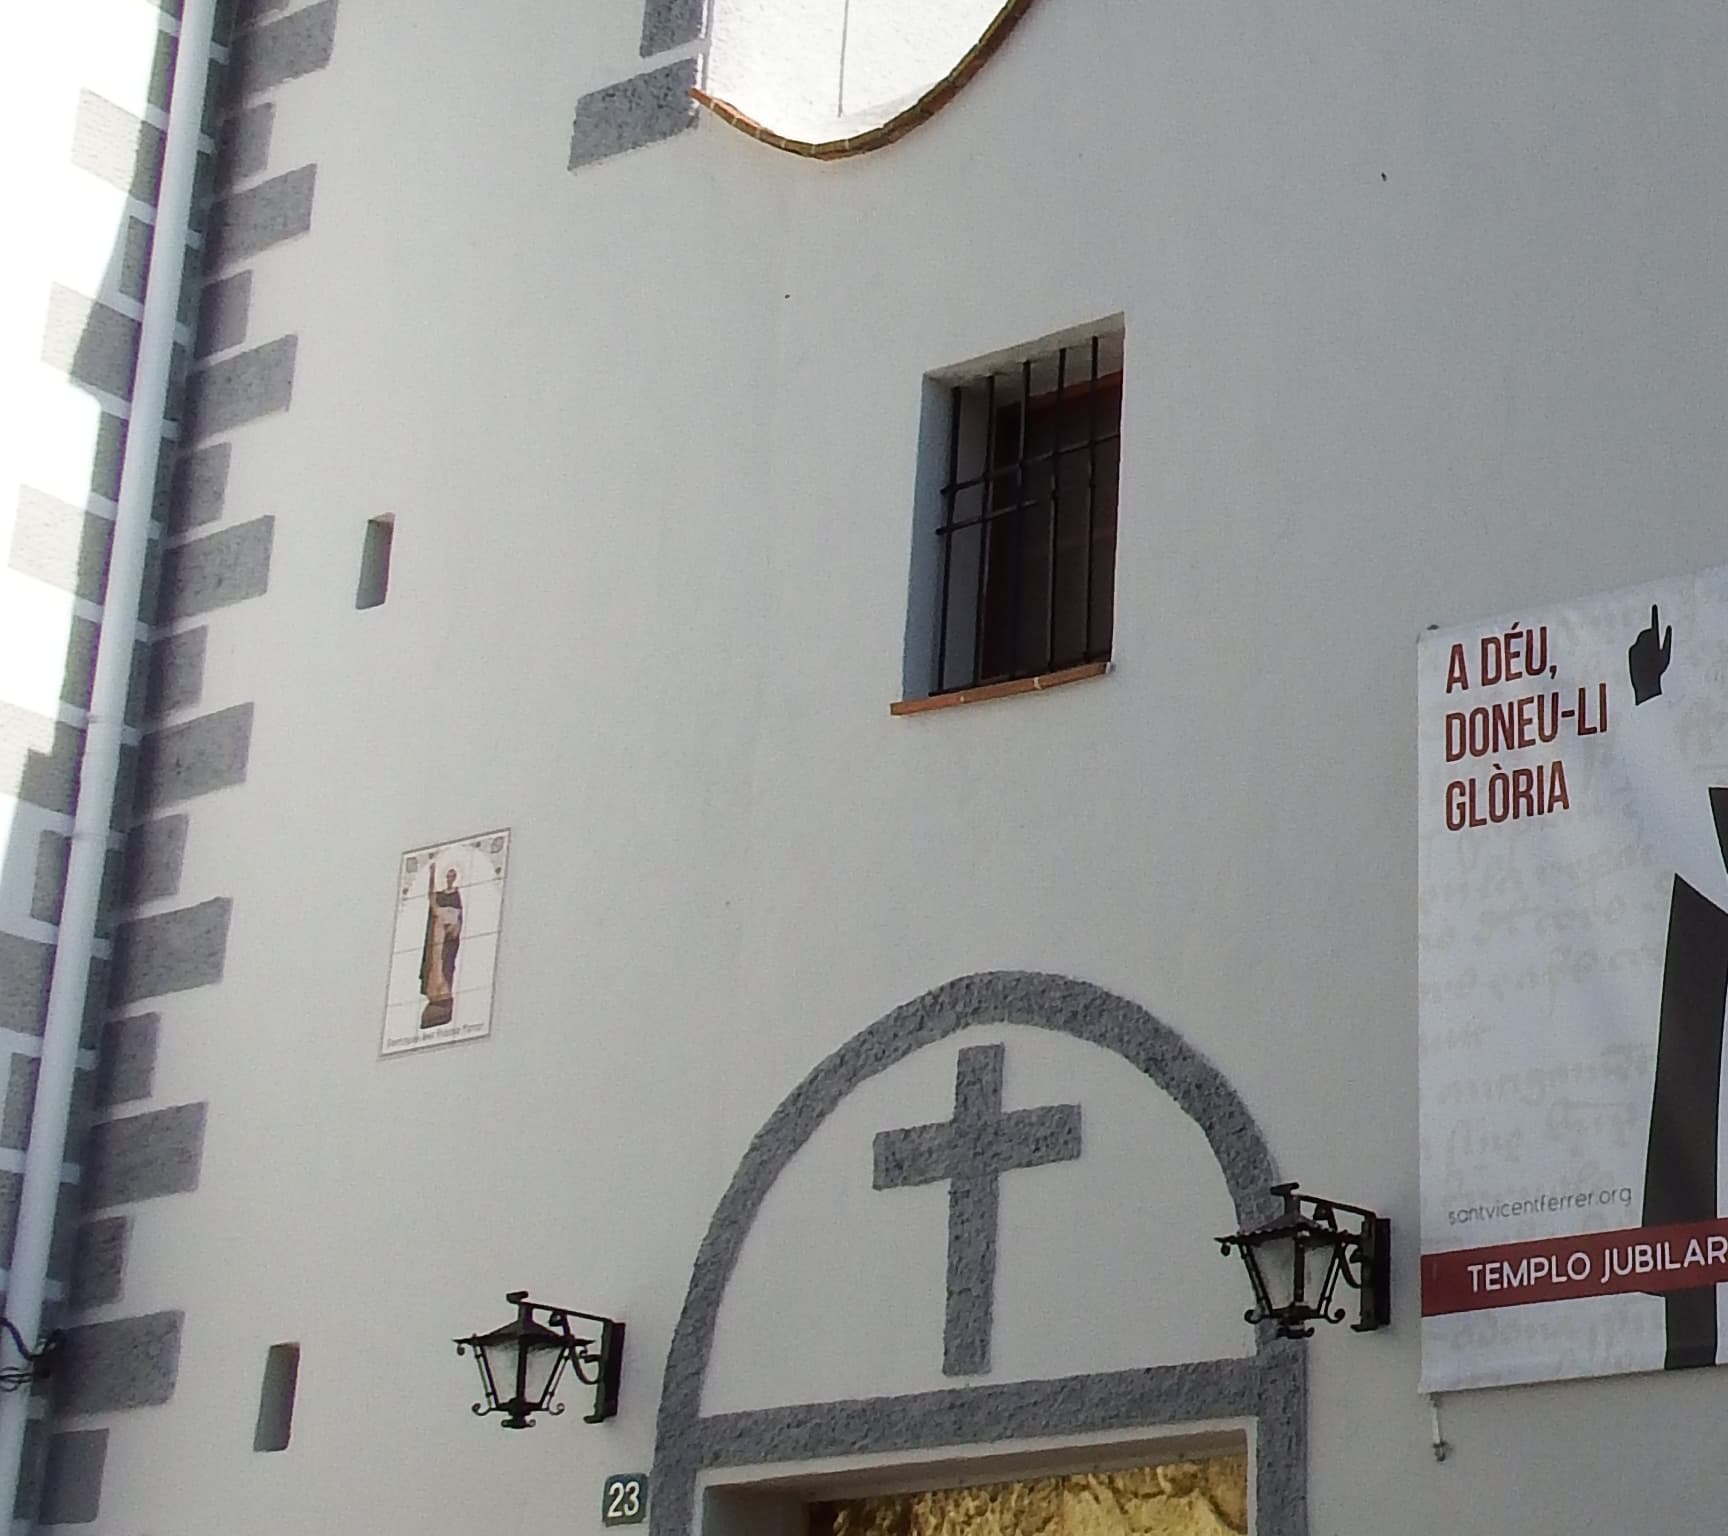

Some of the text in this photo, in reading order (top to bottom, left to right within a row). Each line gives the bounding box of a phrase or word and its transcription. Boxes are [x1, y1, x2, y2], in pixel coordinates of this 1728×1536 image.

[1446, 622, 1557, 693] A DÉU,
[1446, 683, 1607, 762] DONEU-LI
[1446, 760, 1569, 831] GLÒRIA
[1448, 1186, 1632, 1225] santvicentferrer.org
[1467, 1236, 1728, 1292] TEMPLO JUBILAR
[607, 1481, 640, 1517] 23
